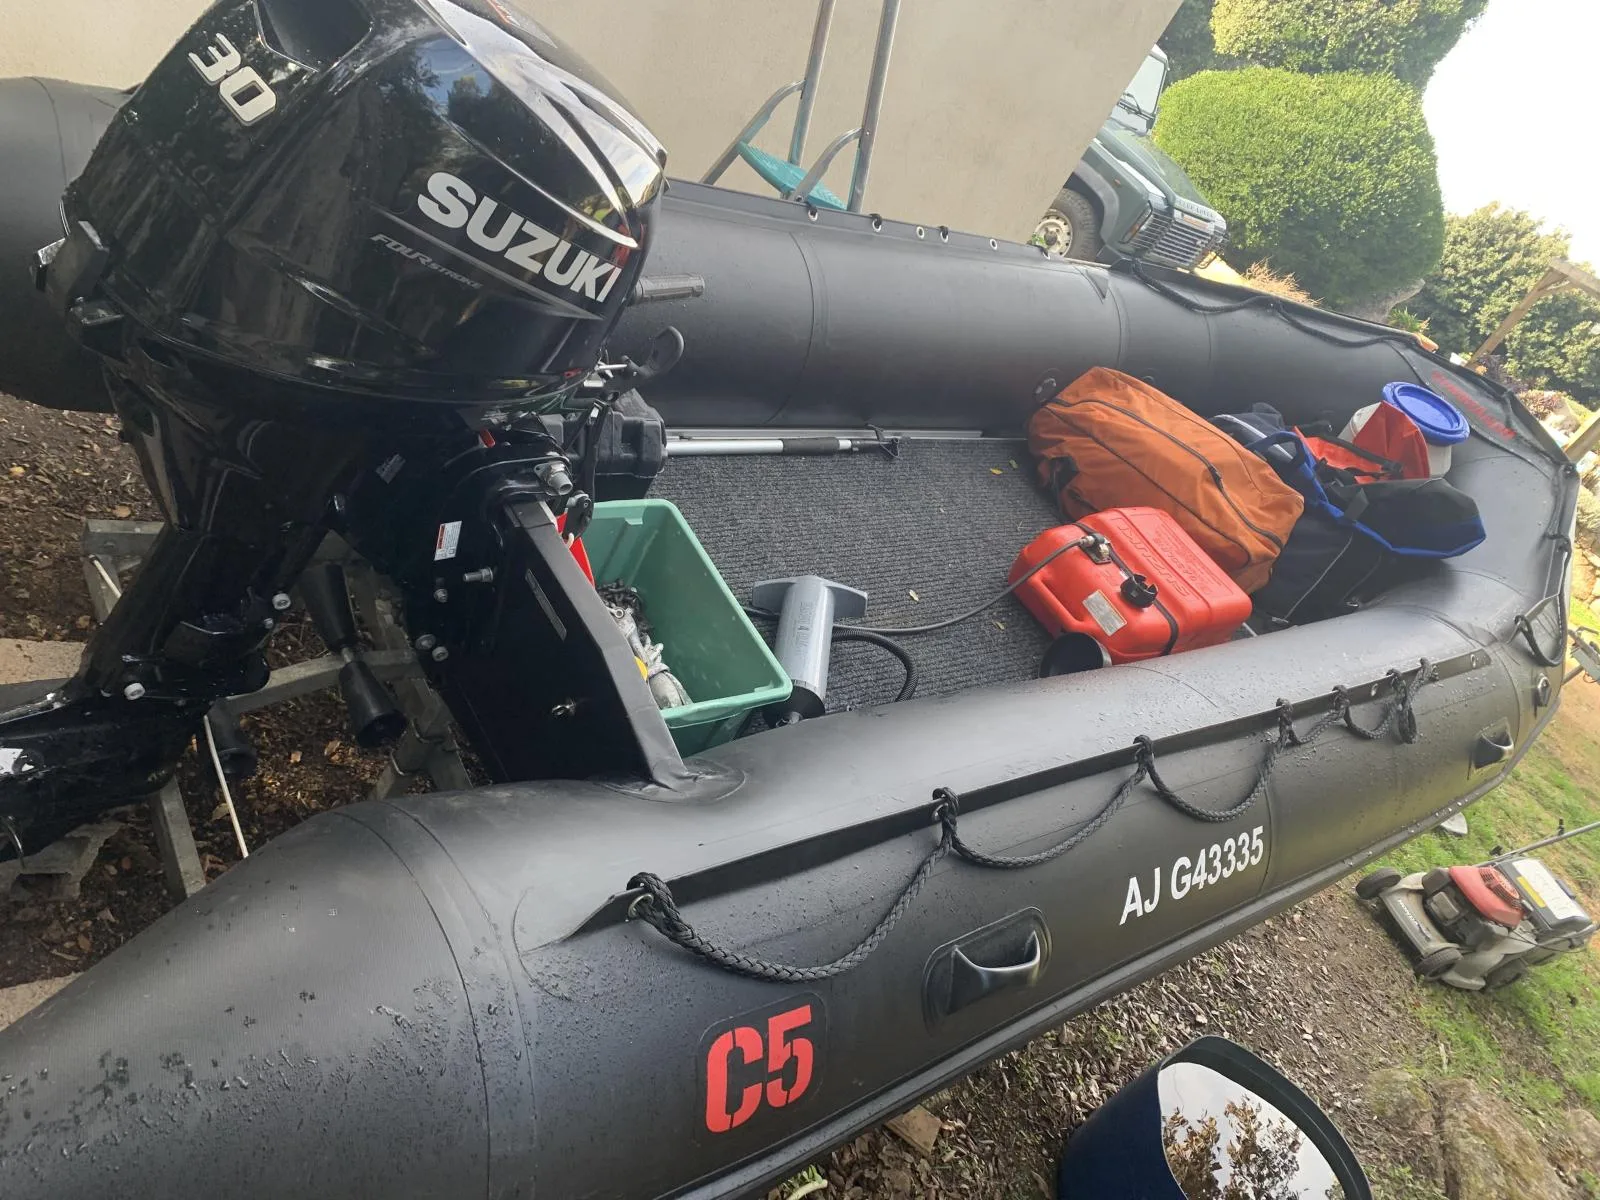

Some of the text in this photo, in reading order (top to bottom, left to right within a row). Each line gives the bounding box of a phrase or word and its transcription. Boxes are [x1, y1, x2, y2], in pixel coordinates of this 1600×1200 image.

[187, 33, 276, 126] 30
[417, 171, 623, 303] SUZUKI
[1119, 825, 1264, 925] AJ G43335
[706, 1004, 813, 1133] C5
